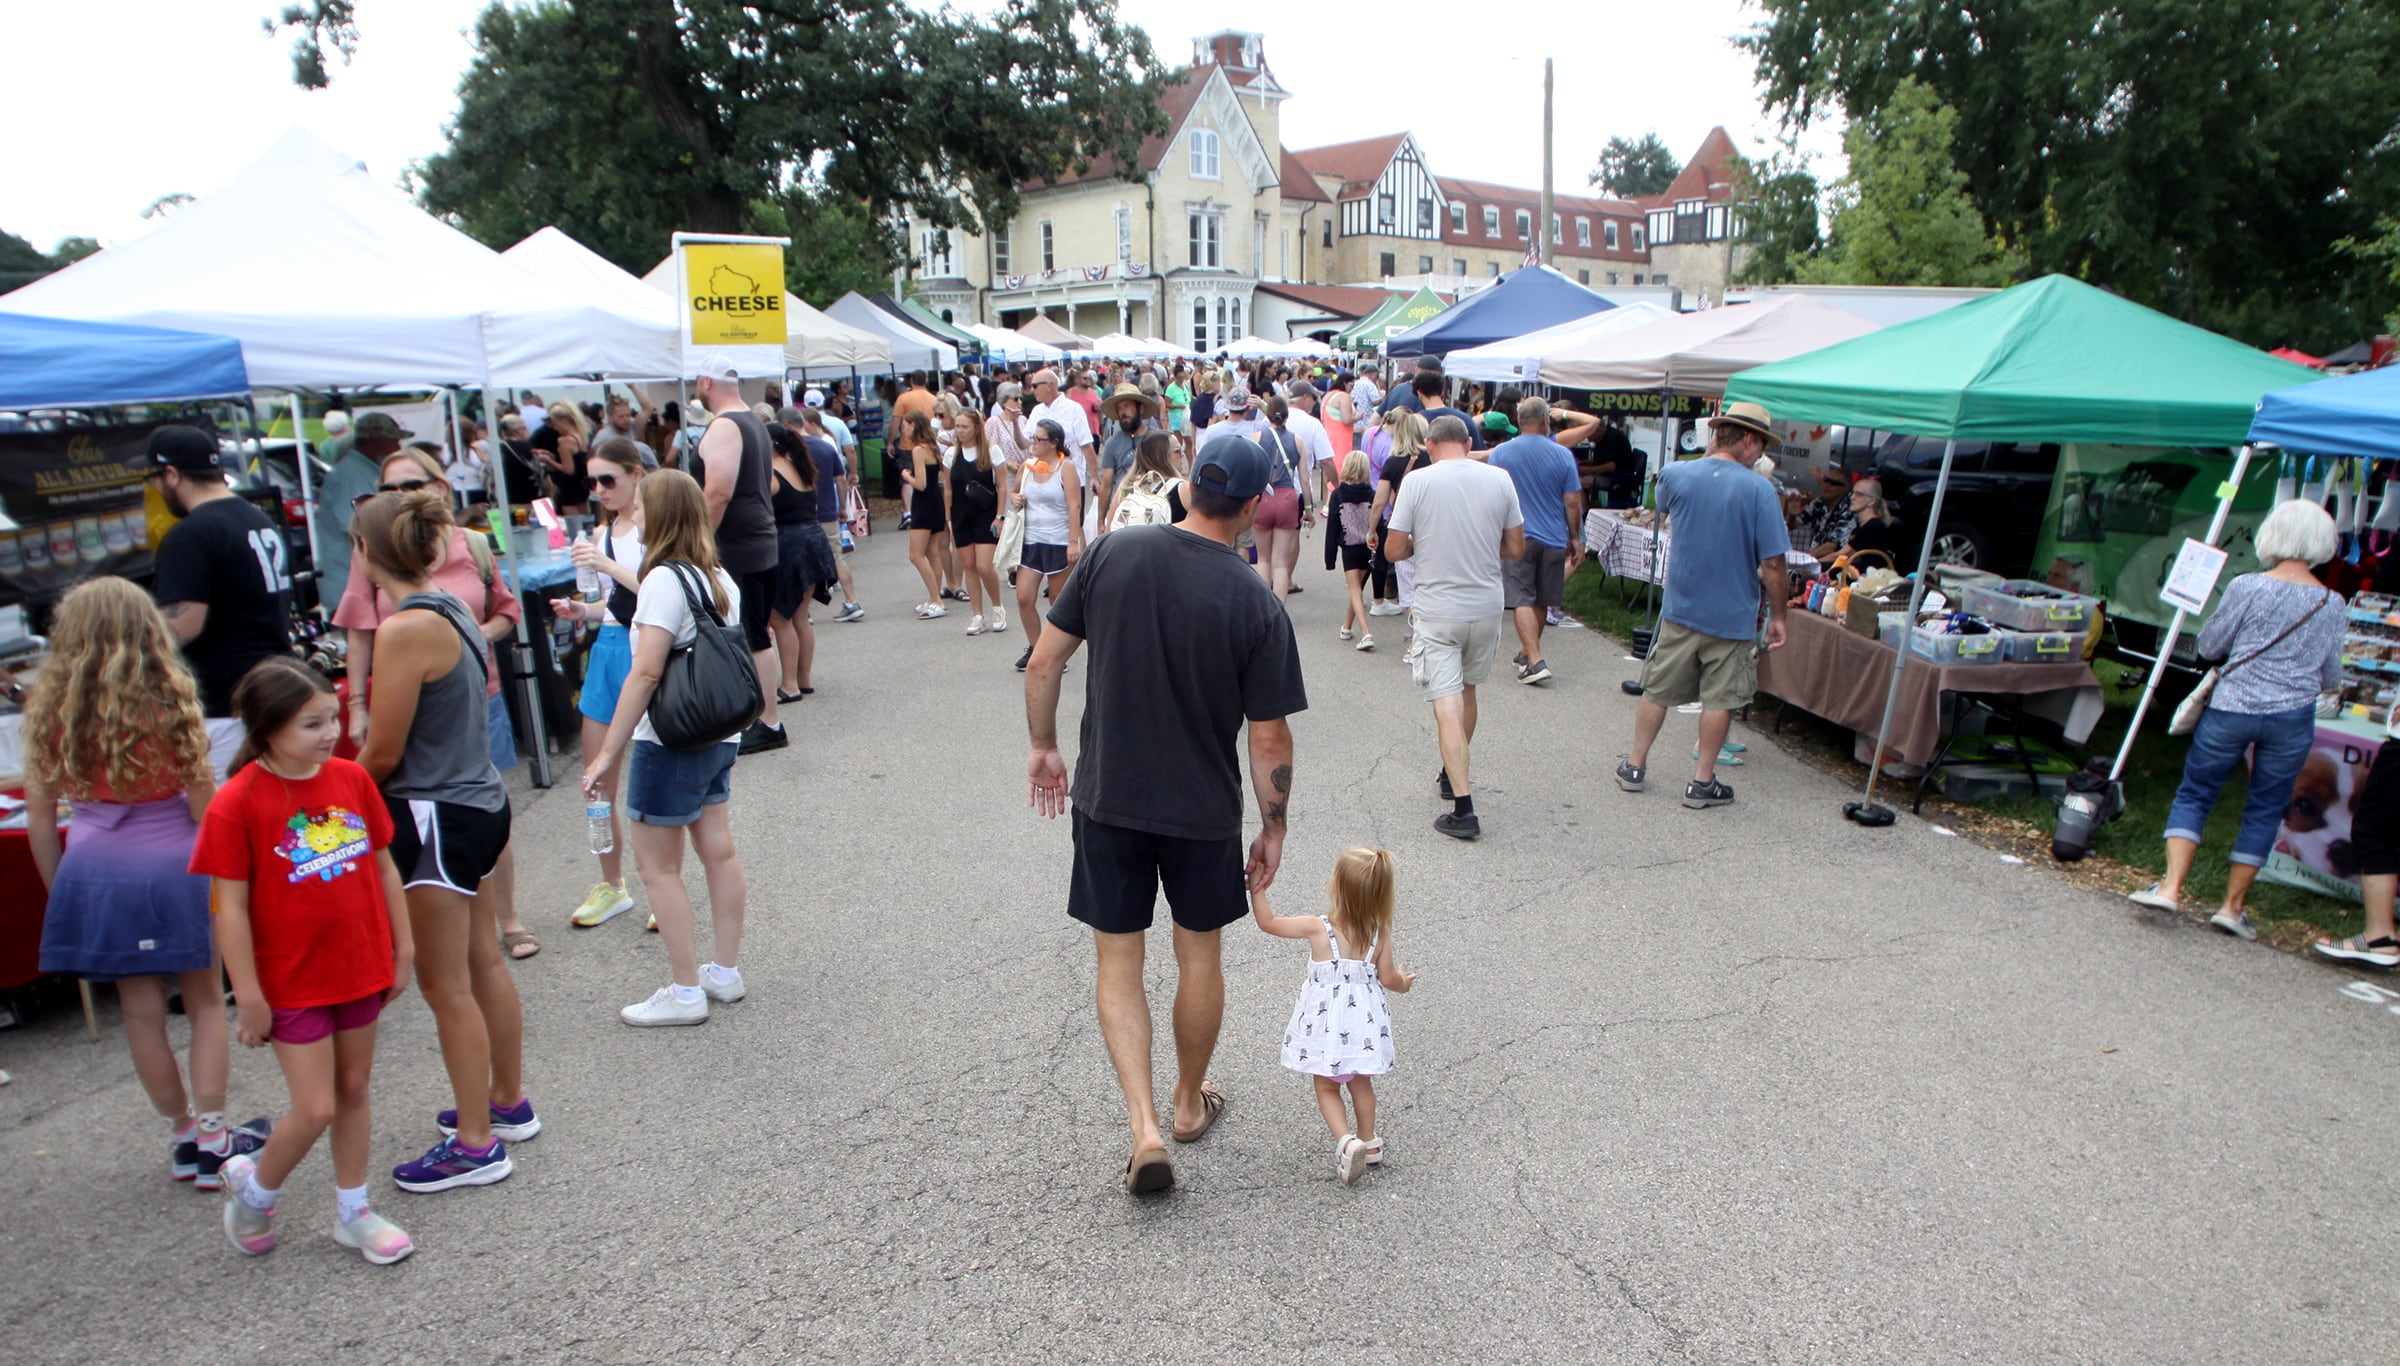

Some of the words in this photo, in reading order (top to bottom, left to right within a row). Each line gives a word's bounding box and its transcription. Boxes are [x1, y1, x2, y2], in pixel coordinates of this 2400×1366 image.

[693, 295, 780, 311] CHEESE
[34, 468, 69, 489] ALL
[247, 527, 291, 593] 12
